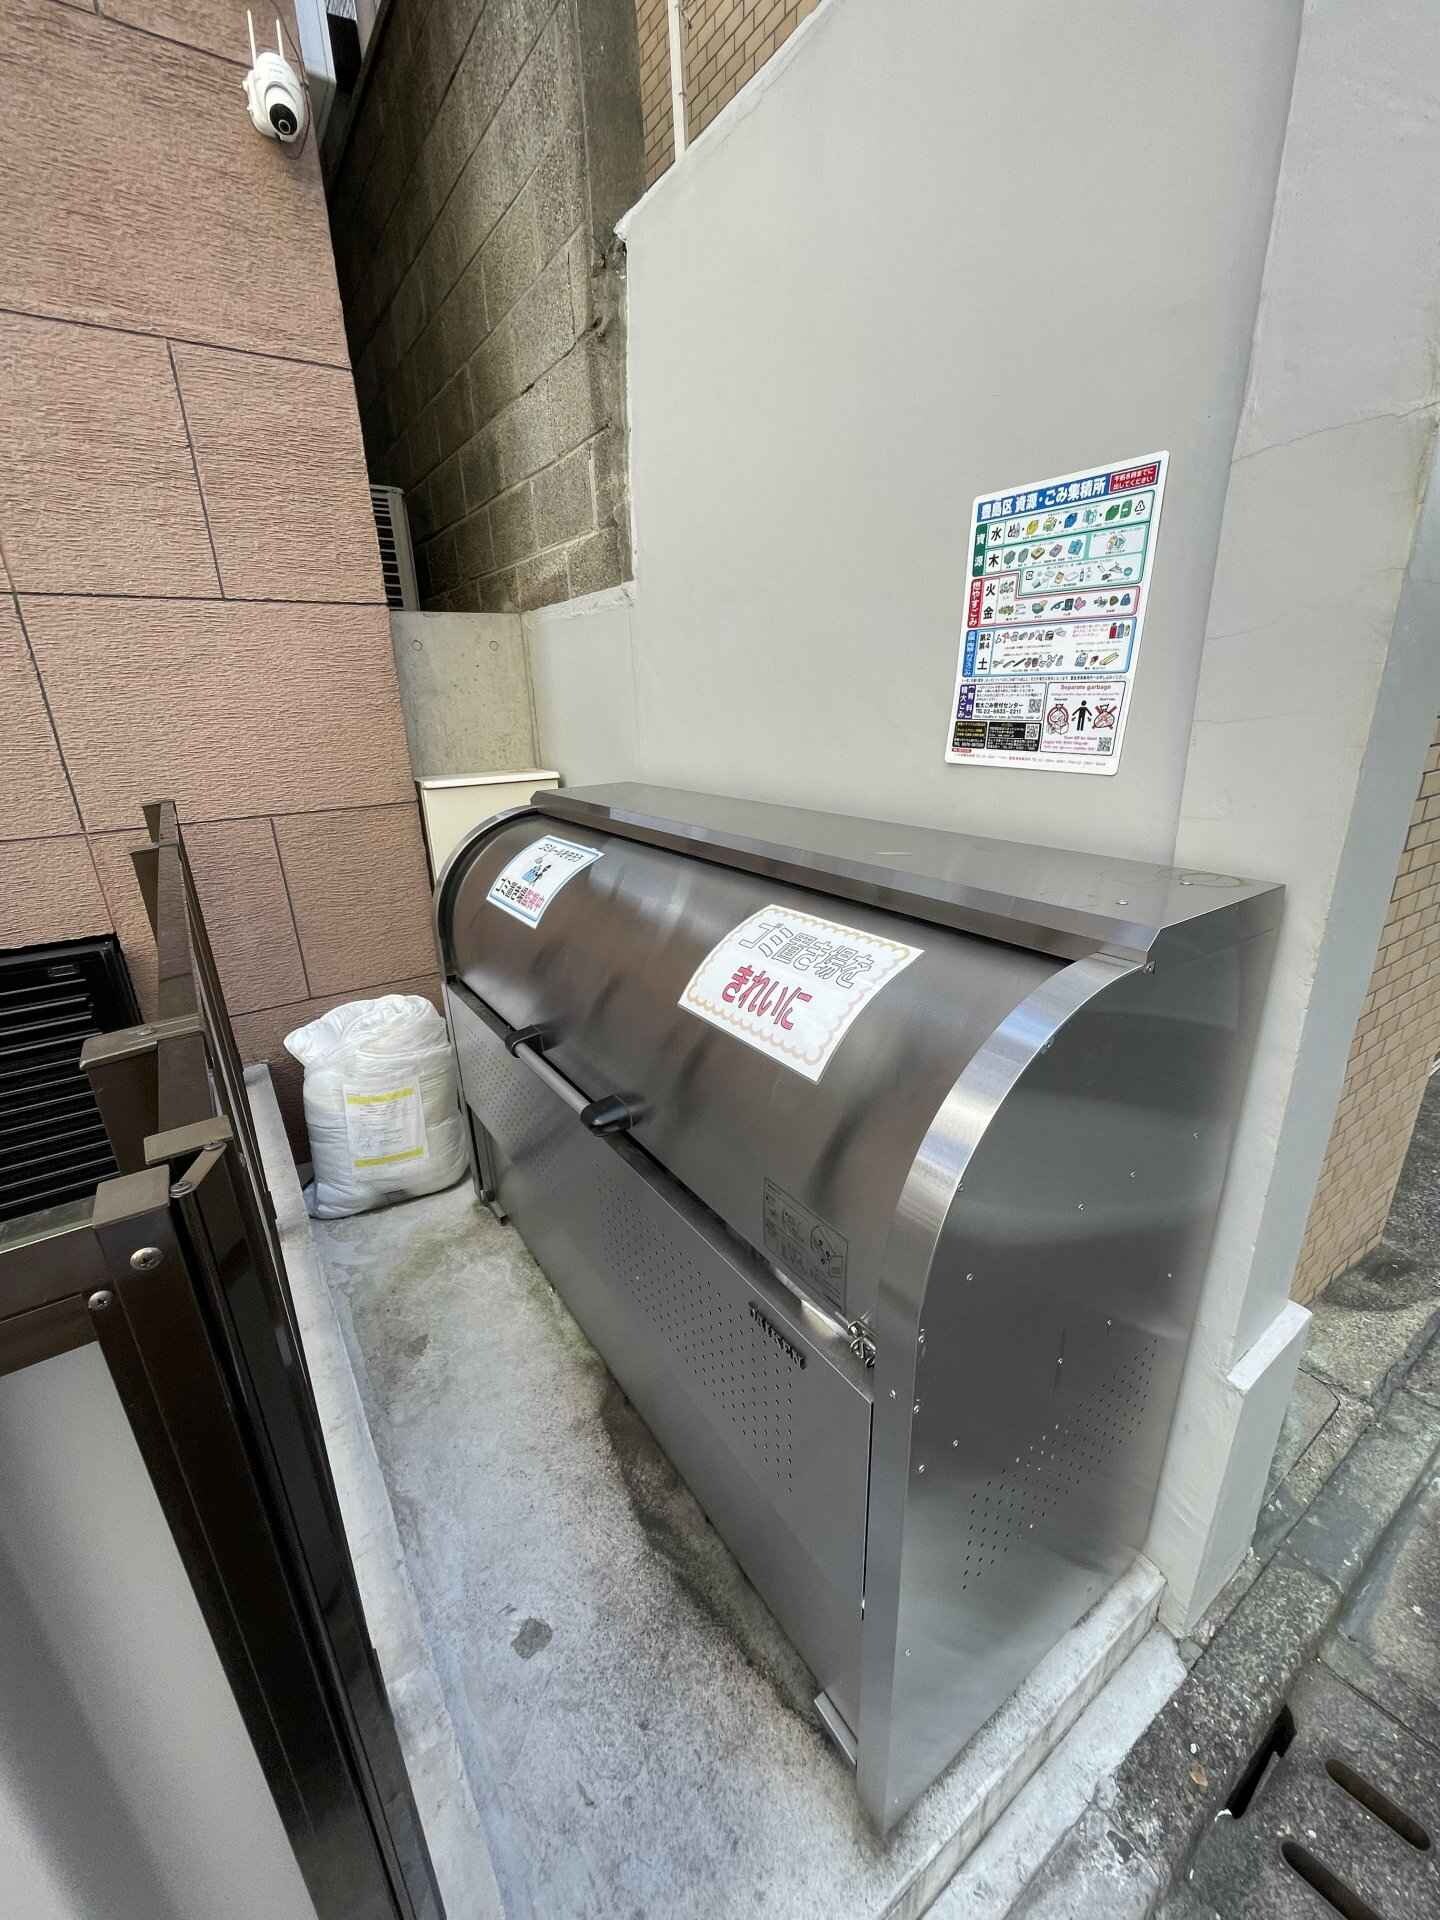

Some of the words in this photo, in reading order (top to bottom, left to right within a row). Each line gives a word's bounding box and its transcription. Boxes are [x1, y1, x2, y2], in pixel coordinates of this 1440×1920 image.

[991, 527, 1002, 541] 水
[988, 554, 1000, 568] 木
[985, 583, 996, 597] 火
[983, 606, 994, 620] 金
[977, 657, 988, 670] 土
[738, 922, 875, 989] ゴミ置き場を
[722, 965, 813, 1031] きれいに
